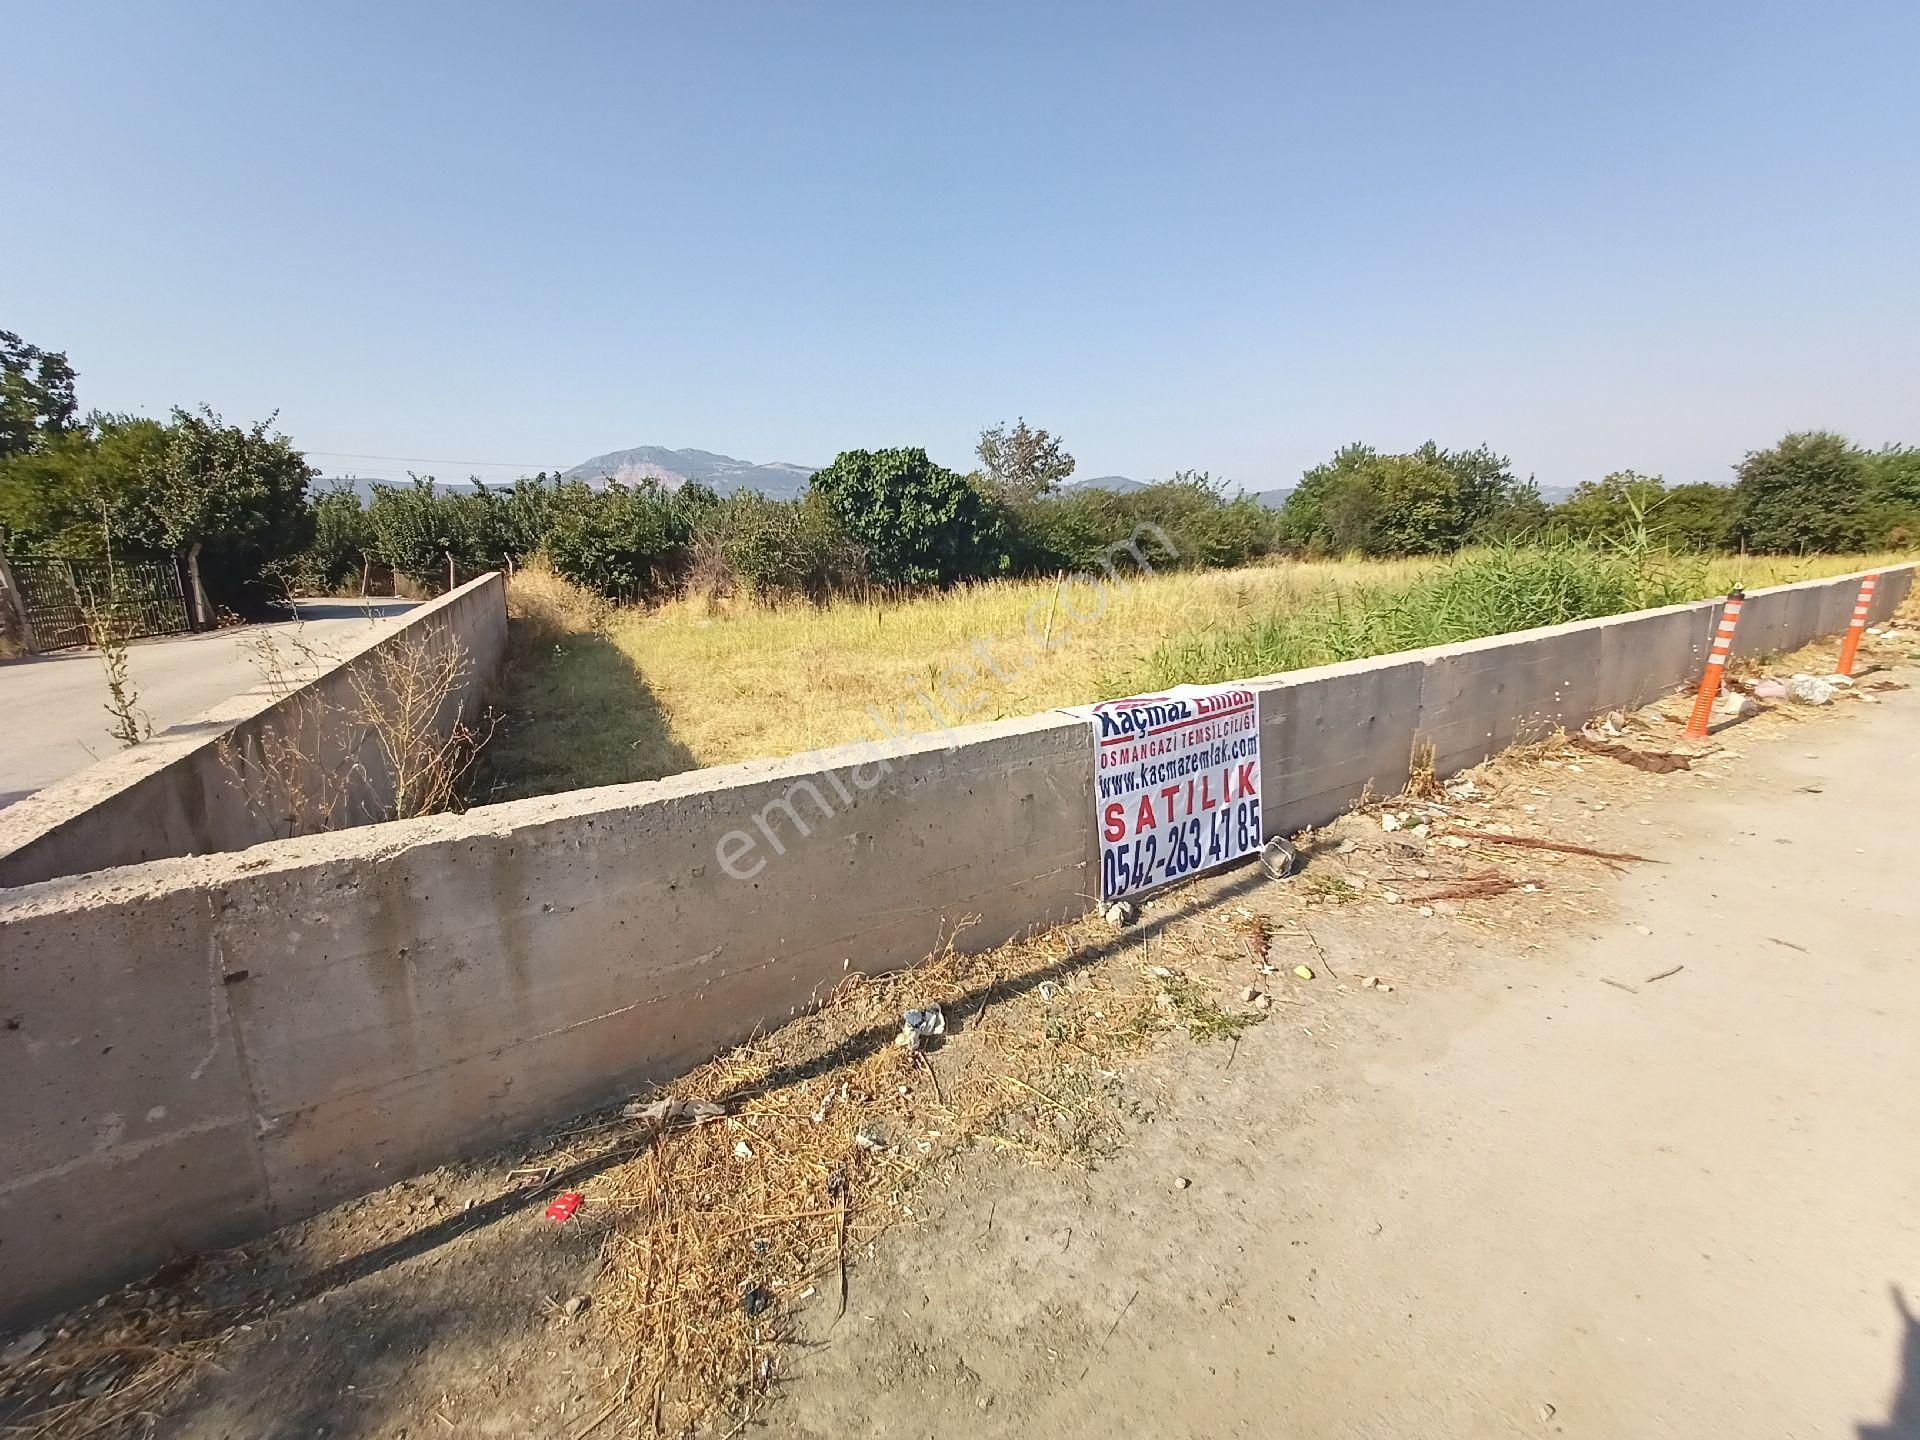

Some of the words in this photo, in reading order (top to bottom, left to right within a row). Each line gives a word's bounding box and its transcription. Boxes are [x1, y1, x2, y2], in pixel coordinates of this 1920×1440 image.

[1093, 700, 1191, 738] Kaçmaz
[1100, 734, 1177, 769] OSMANGAZİ
[1182, 711, 1255, 748] TEMSİLCİLİĞİ
[1099, 734, 1257, 798] www.kacmazemlak.com
[1104, 761, 1256, 842] SATILIK
[1104, 818, 1201, 900] 0542-263
[1209, 808, 1230, 861] 47
[1238, 799, 1260, 852] 85
